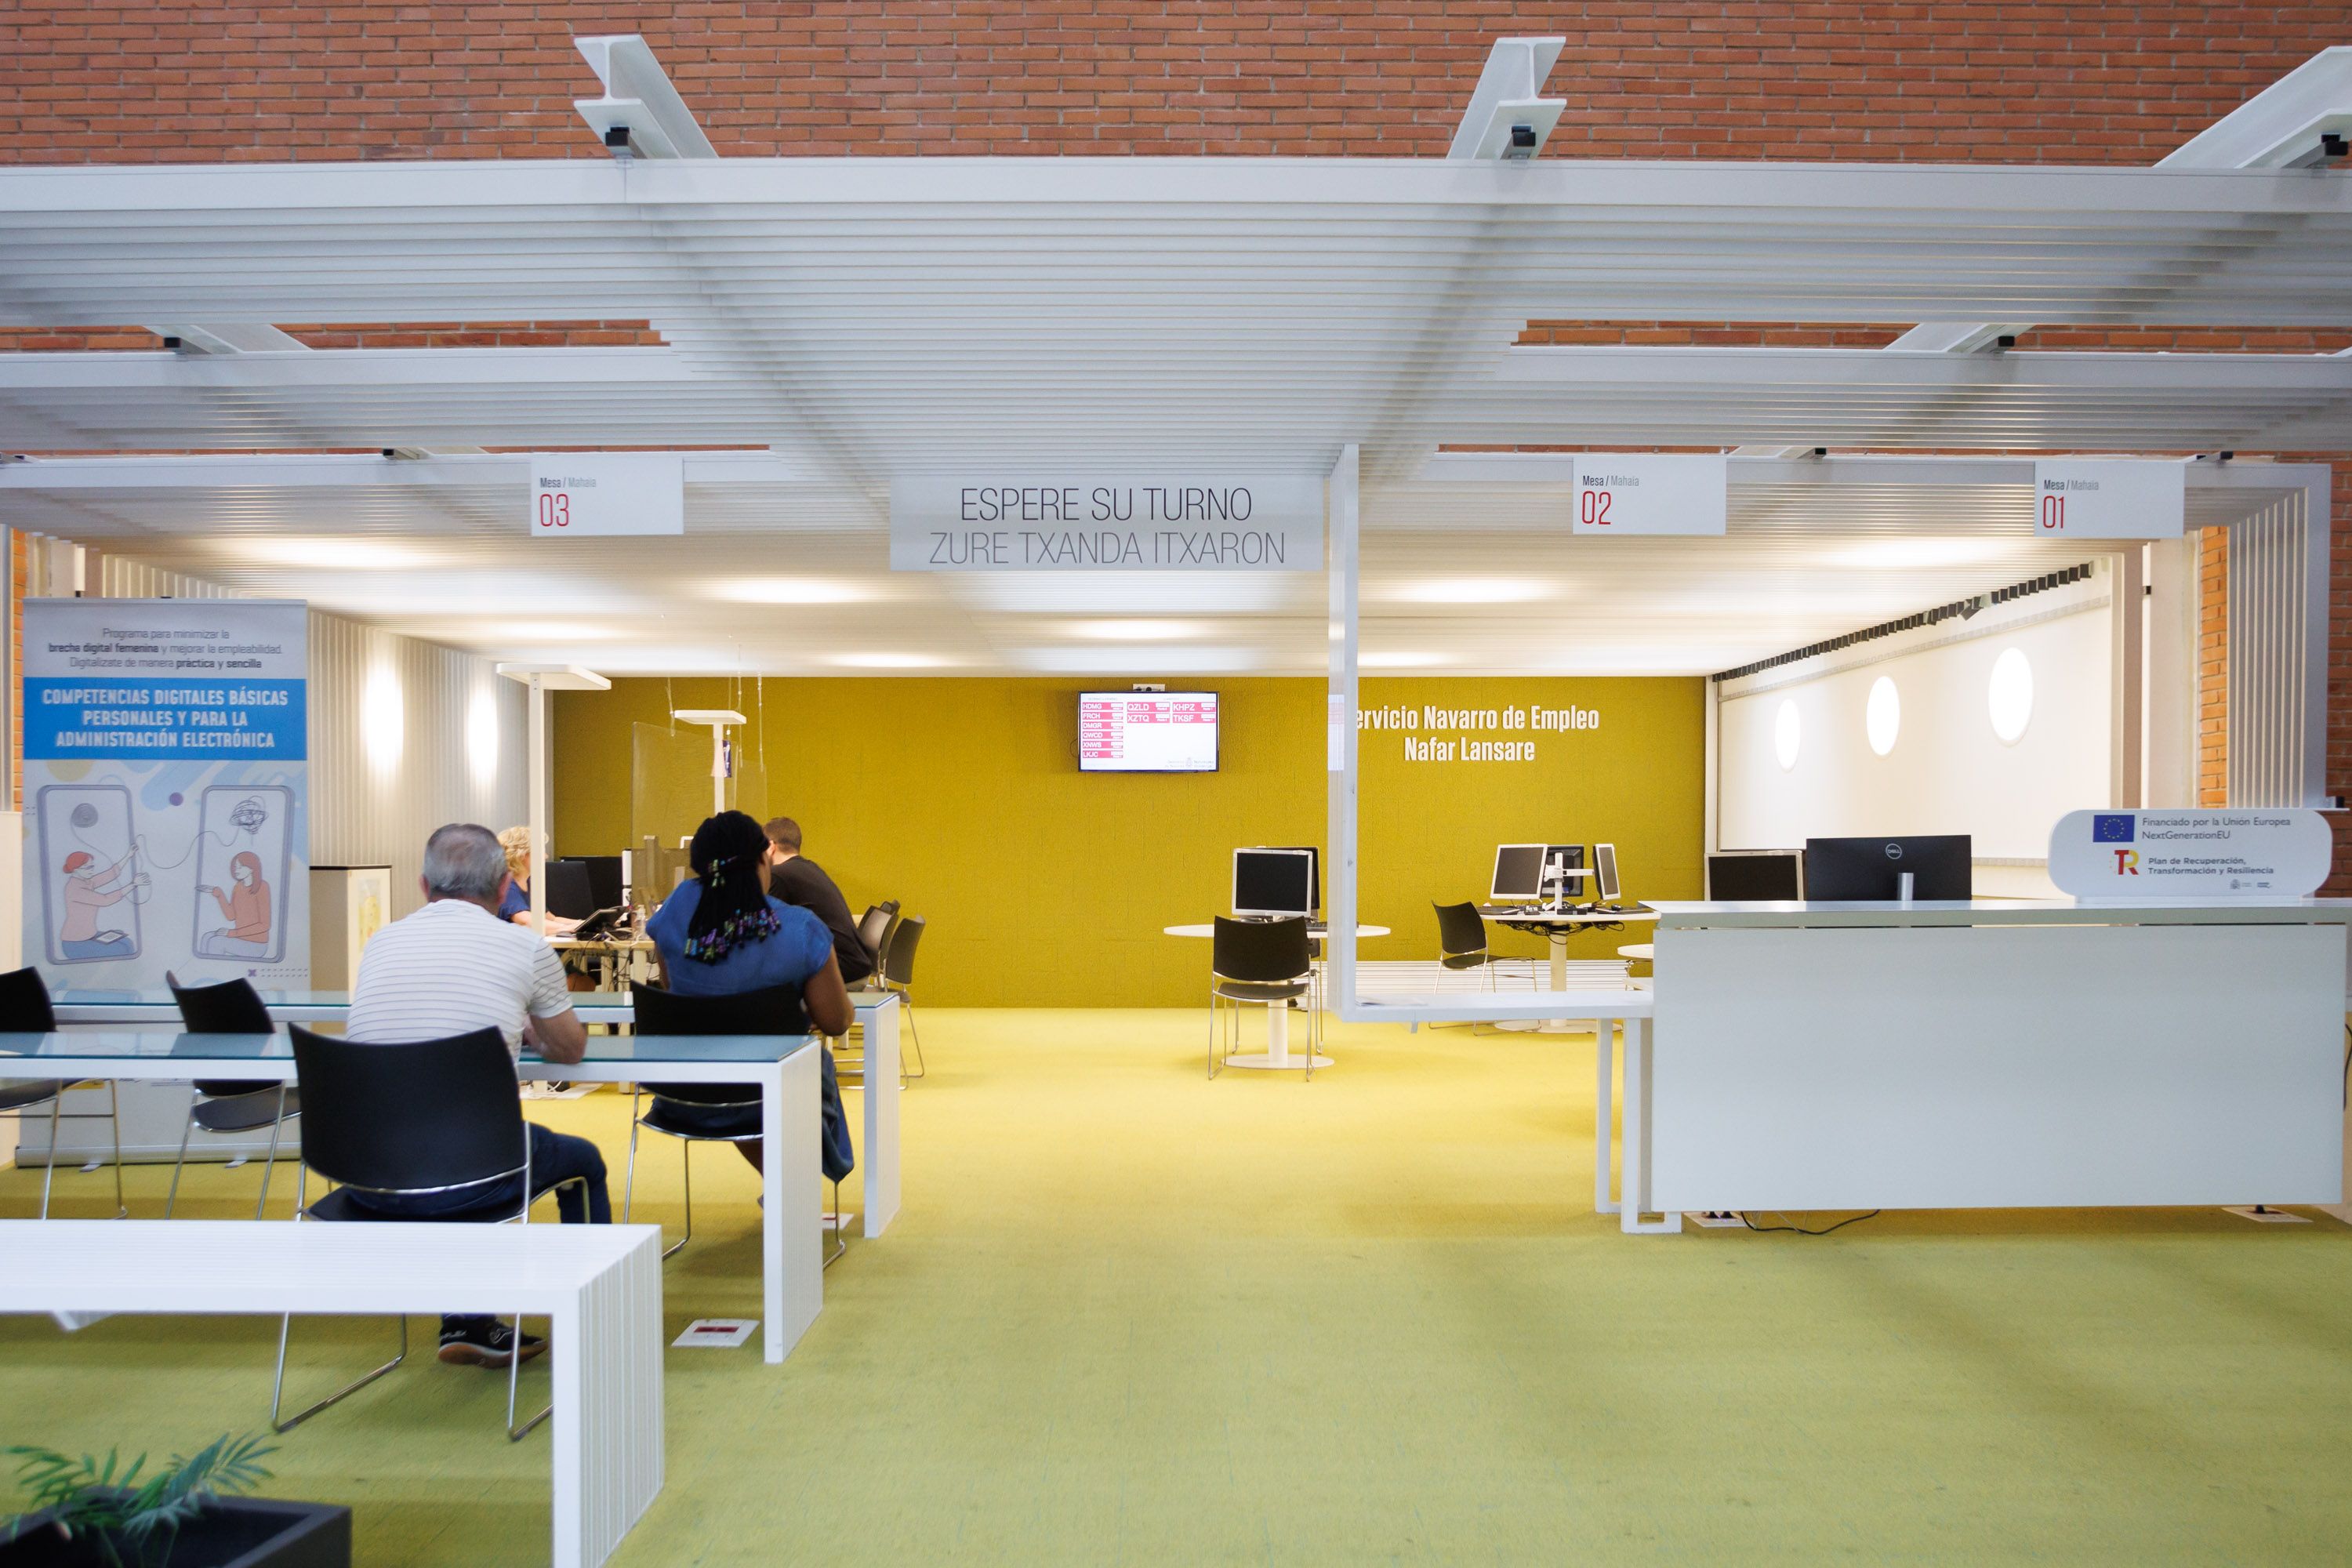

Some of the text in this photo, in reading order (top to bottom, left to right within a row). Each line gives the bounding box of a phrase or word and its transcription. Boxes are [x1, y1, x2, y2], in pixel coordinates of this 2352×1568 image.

[539, 477, 561, 488] Mesa
[568, 477, 597, 488] Mahaia
[1582, 475, 1604, 486] Mesa
[1610, 475, 1639, 487] Mahaia
[2043, 479, 2065, 490] Mesa
[2071, 480, 2100, 491] Mahaia
[539, 493, 569, 527] 03
[961, 488, 1253, 521] ESPERE SU TURNO
[1581, 490, 1612, 525] 02
[2042, 495, 2065, 529] 01
[929, 532, 1285, 564] ZURE TXANDA ITXARON
[102, 628, 230, 641] Programa para minimizar la
[48, 643, 81, 652] brecha
[83, 643, 113, 655] digital
[115, 643, 158, 653] femenina
[160, 645, 168, 655] y
[169, 644, 205, 655] mejorar
[207, 644, 216, 654] la
[125, 657, 136, 667] de
[138, 659, 174, 668] manera
[217, 660, 224, 670] y
[227, 658, 262, 668] sencilla
[42, 686, 289, 706] COMPETENCIAS DIGITALES BÁSICAS
[82, 710, 248, 726] PERSONALES Y PARA LA
[1356, 705, 1600, 732] ervicio Navarro de Empleo
[56, 728, 275, 748] ADMINISTRACIÓN ELECTRÓNICA
[1404, 737, 1536, 761] Nafar Lansare
[2142, 816, 2291, 828] Financiado por la Unión Europea
[2142, 830, 2231, 840] NextGenerationEU
[2183, 856, 2246, 866] Recuperación,
[2147, 866, 2216, 875] Transformación
